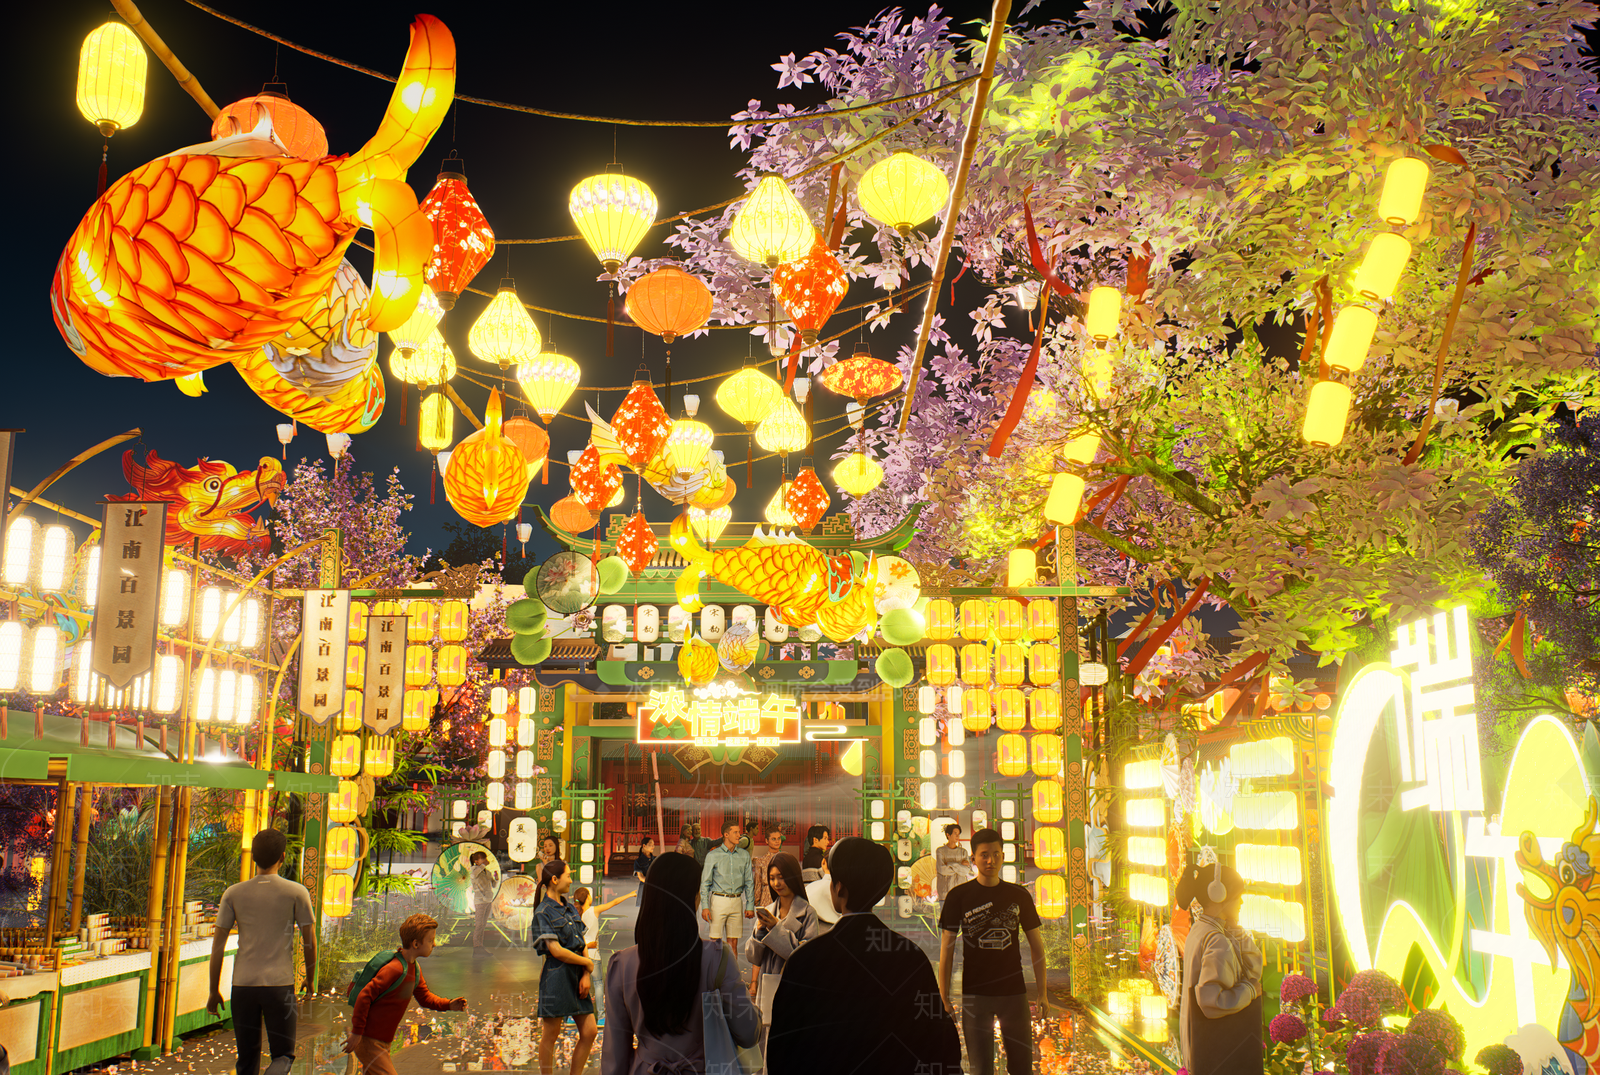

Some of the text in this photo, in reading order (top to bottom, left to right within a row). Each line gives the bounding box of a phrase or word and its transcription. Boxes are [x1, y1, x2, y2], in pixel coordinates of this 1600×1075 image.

[112, 508, 144, 665] 江南百景园
[313, 593, 334, 708] 江南百景园
[376, 620, 394, 721] 江南百景园
[648, 685, 799, 737] 浓情端午
